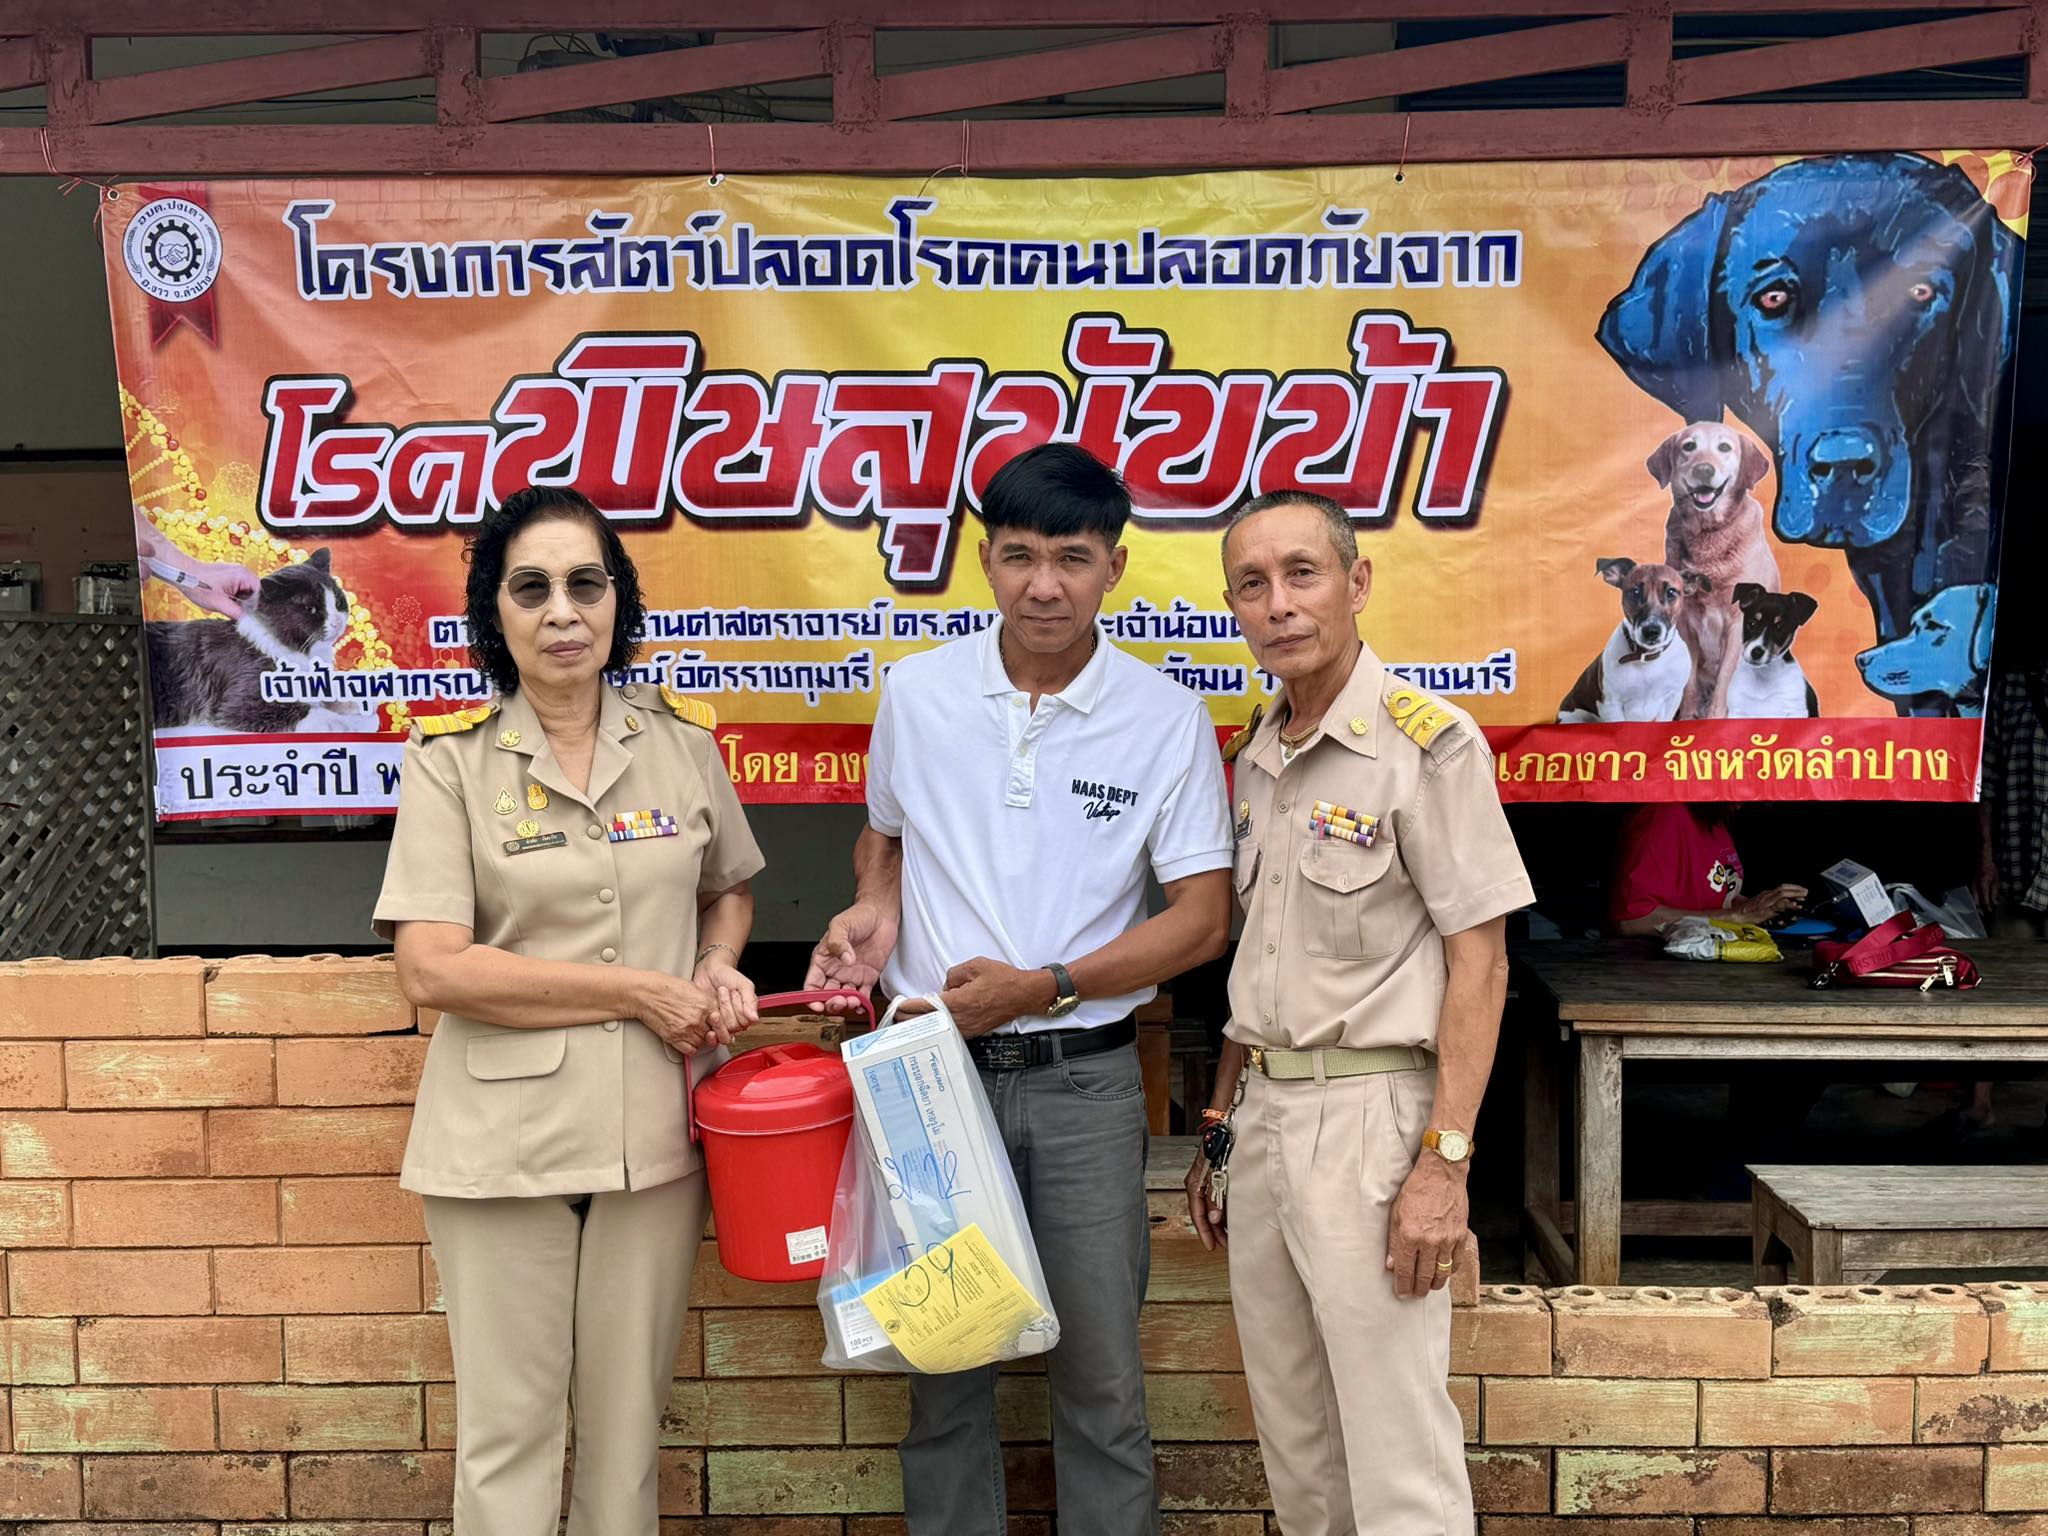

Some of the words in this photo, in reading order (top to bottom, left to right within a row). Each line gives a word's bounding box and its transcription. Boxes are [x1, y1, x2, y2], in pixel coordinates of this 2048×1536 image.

[137, 200, 205, 226] อบต.ปงเตา
[286, 198, 1520, 299] โครงการสัตว์ปลอดโรคคนปลอดภัยจาก
[641, 601, 889, 638] านศาสตราจารย์
[892, 609, 1000, 637] ดร.สม
[675, 652, 870, 702] อัครราชกุมารี
[1158, 654, 1244, 691] วัฒน
[1385, 652, 1512, 690] ราชนารี
[181, 745, 359, 802] ประจำปี
[719, 733, 799, 785] โดย
[814, 751, 869, 783] อง
[1664, 732, 1950, 783] จังหวัดลำปาง
[1071, 778, 1106, 800] HAAS
[1106, 785, 1139, 807] DEPT
[928, 1052, 946, 1093] TERUMO
